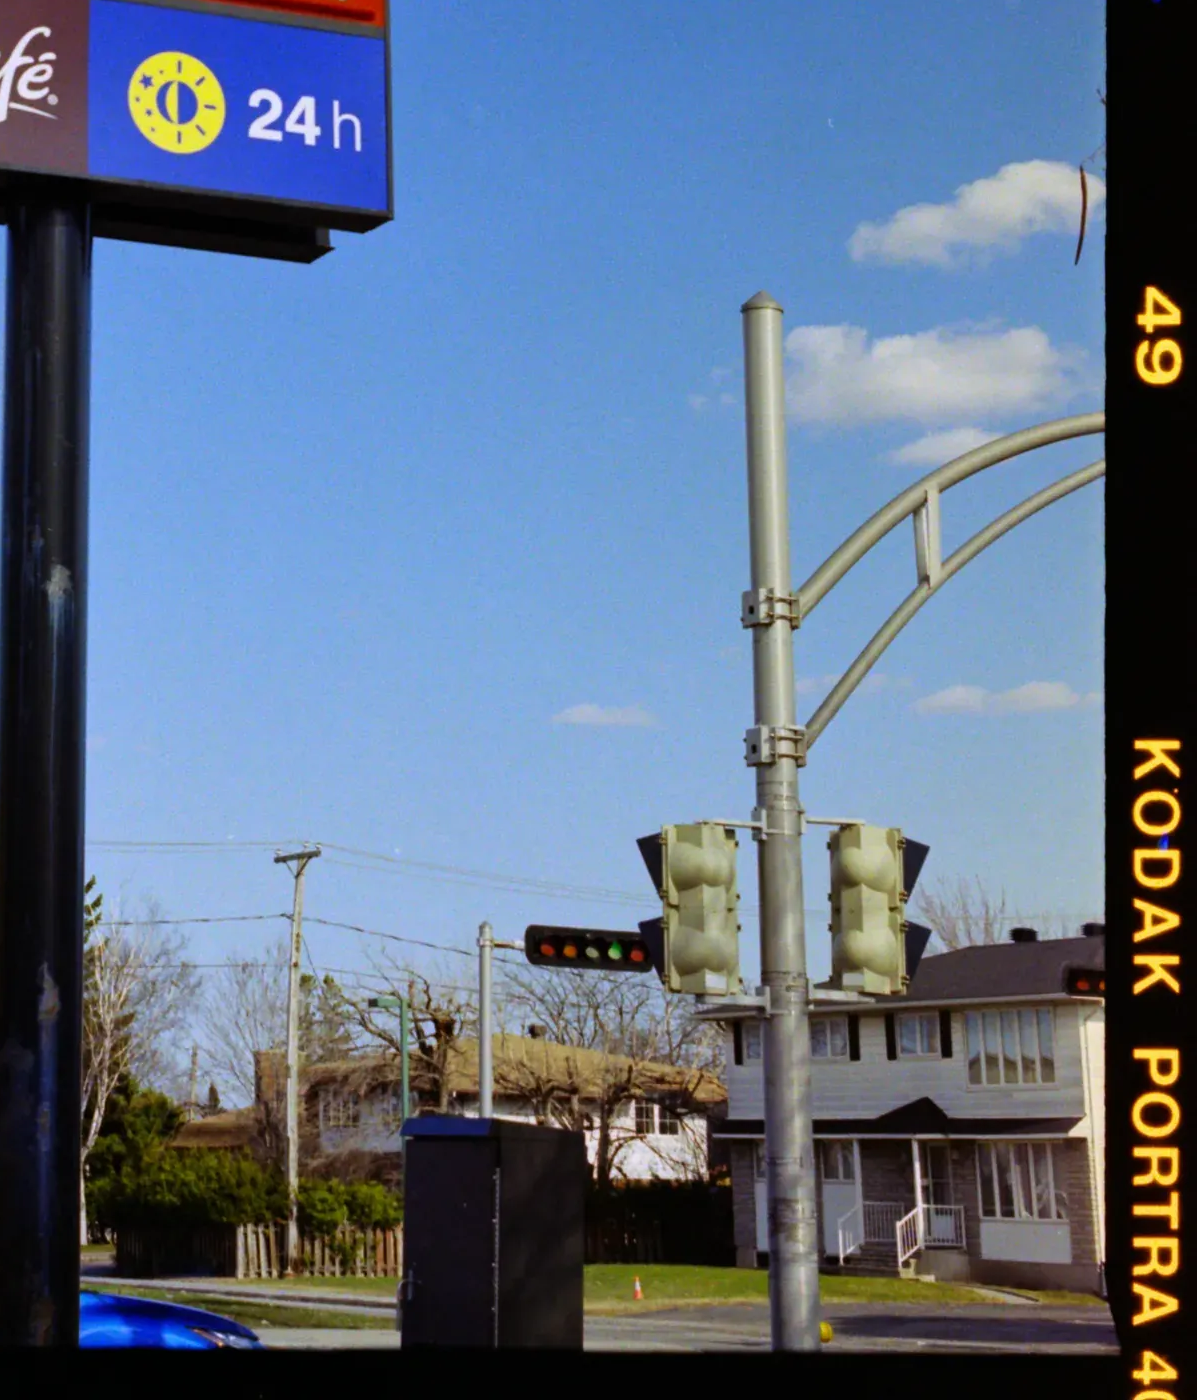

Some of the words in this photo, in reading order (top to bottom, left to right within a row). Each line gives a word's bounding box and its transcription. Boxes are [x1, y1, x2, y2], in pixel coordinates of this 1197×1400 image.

[1135, 285, 1183, 386] 49
[1132, 739, 1182, 995] KODAK
[1131, 1047, 1181, 1326] PORTRA
